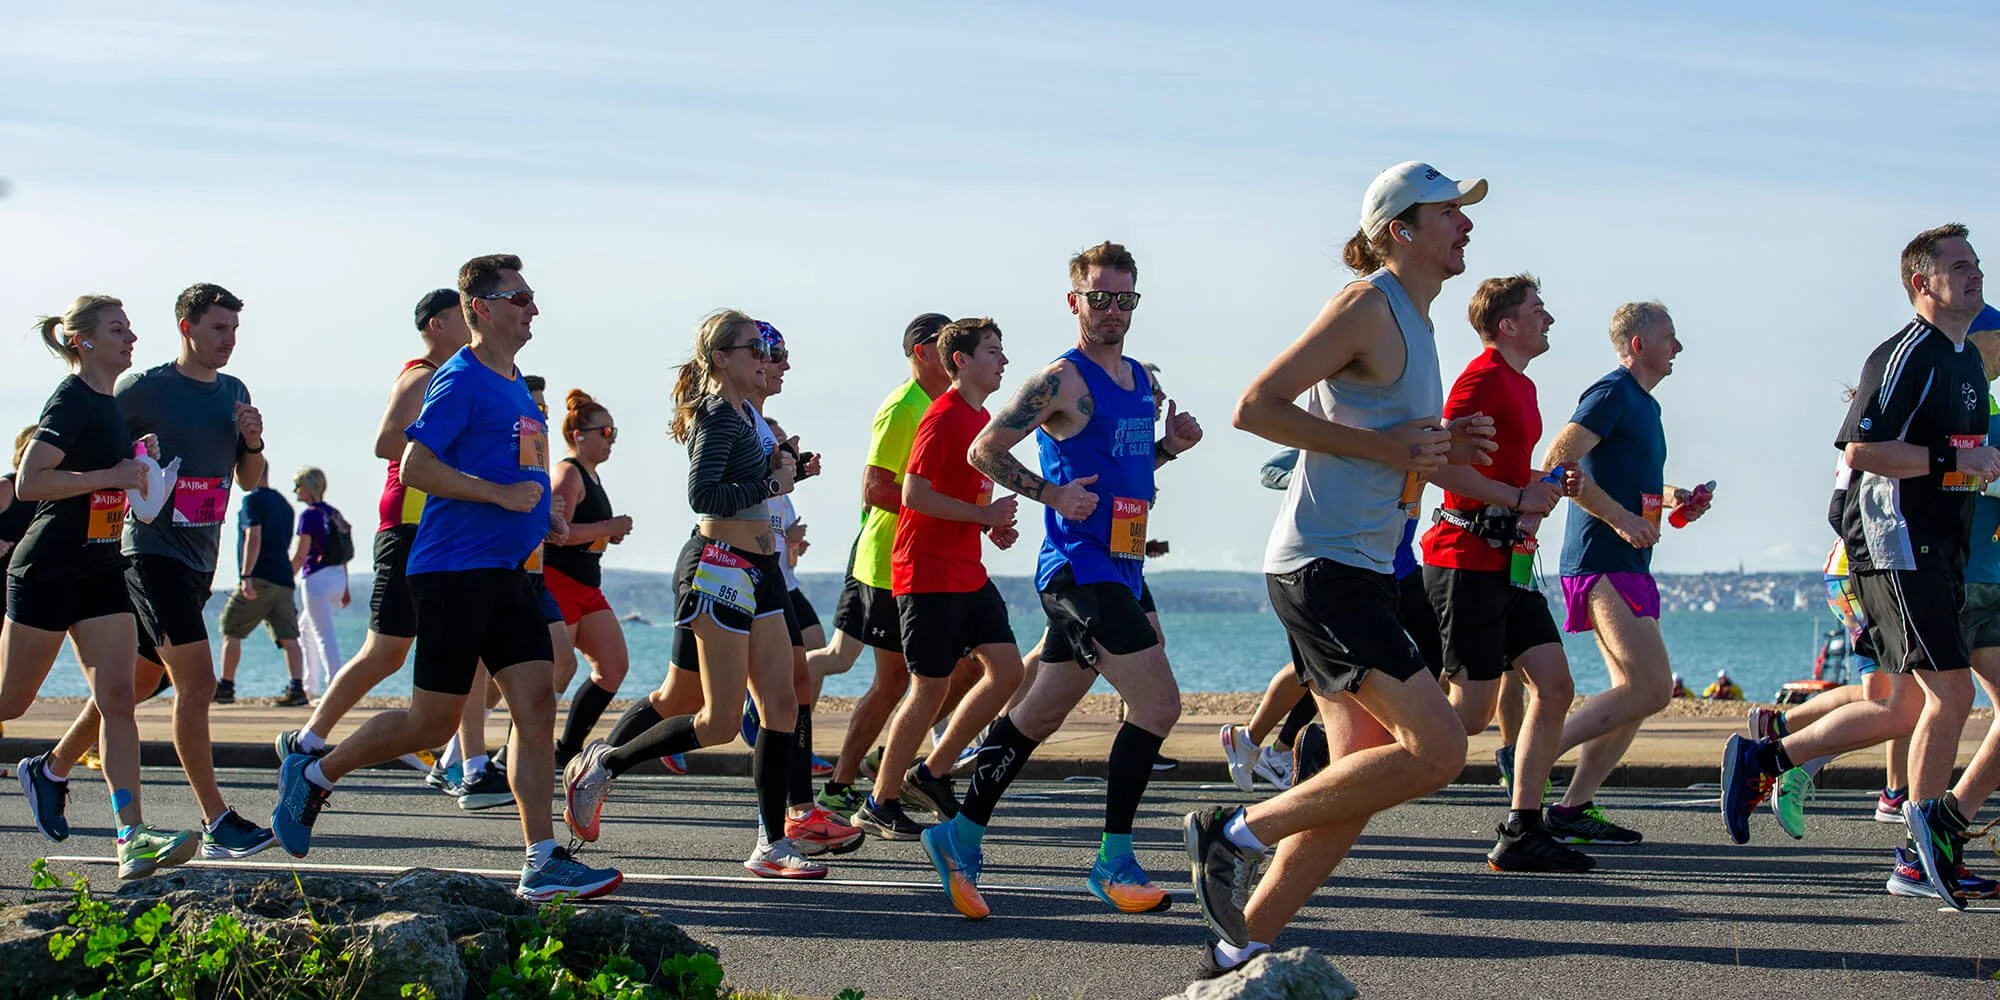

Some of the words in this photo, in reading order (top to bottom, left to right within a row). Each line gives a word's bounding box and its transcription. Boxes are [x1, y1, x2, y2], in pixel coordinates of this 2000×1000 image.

[186, 481, 209, 490] AJBell
[1122, 503, 1142, 514] AJBell
[712, 551, 737, 567] AJBell
[719, 584, 738, 603] 956
[991, 747, 1016, 783] 2XU
